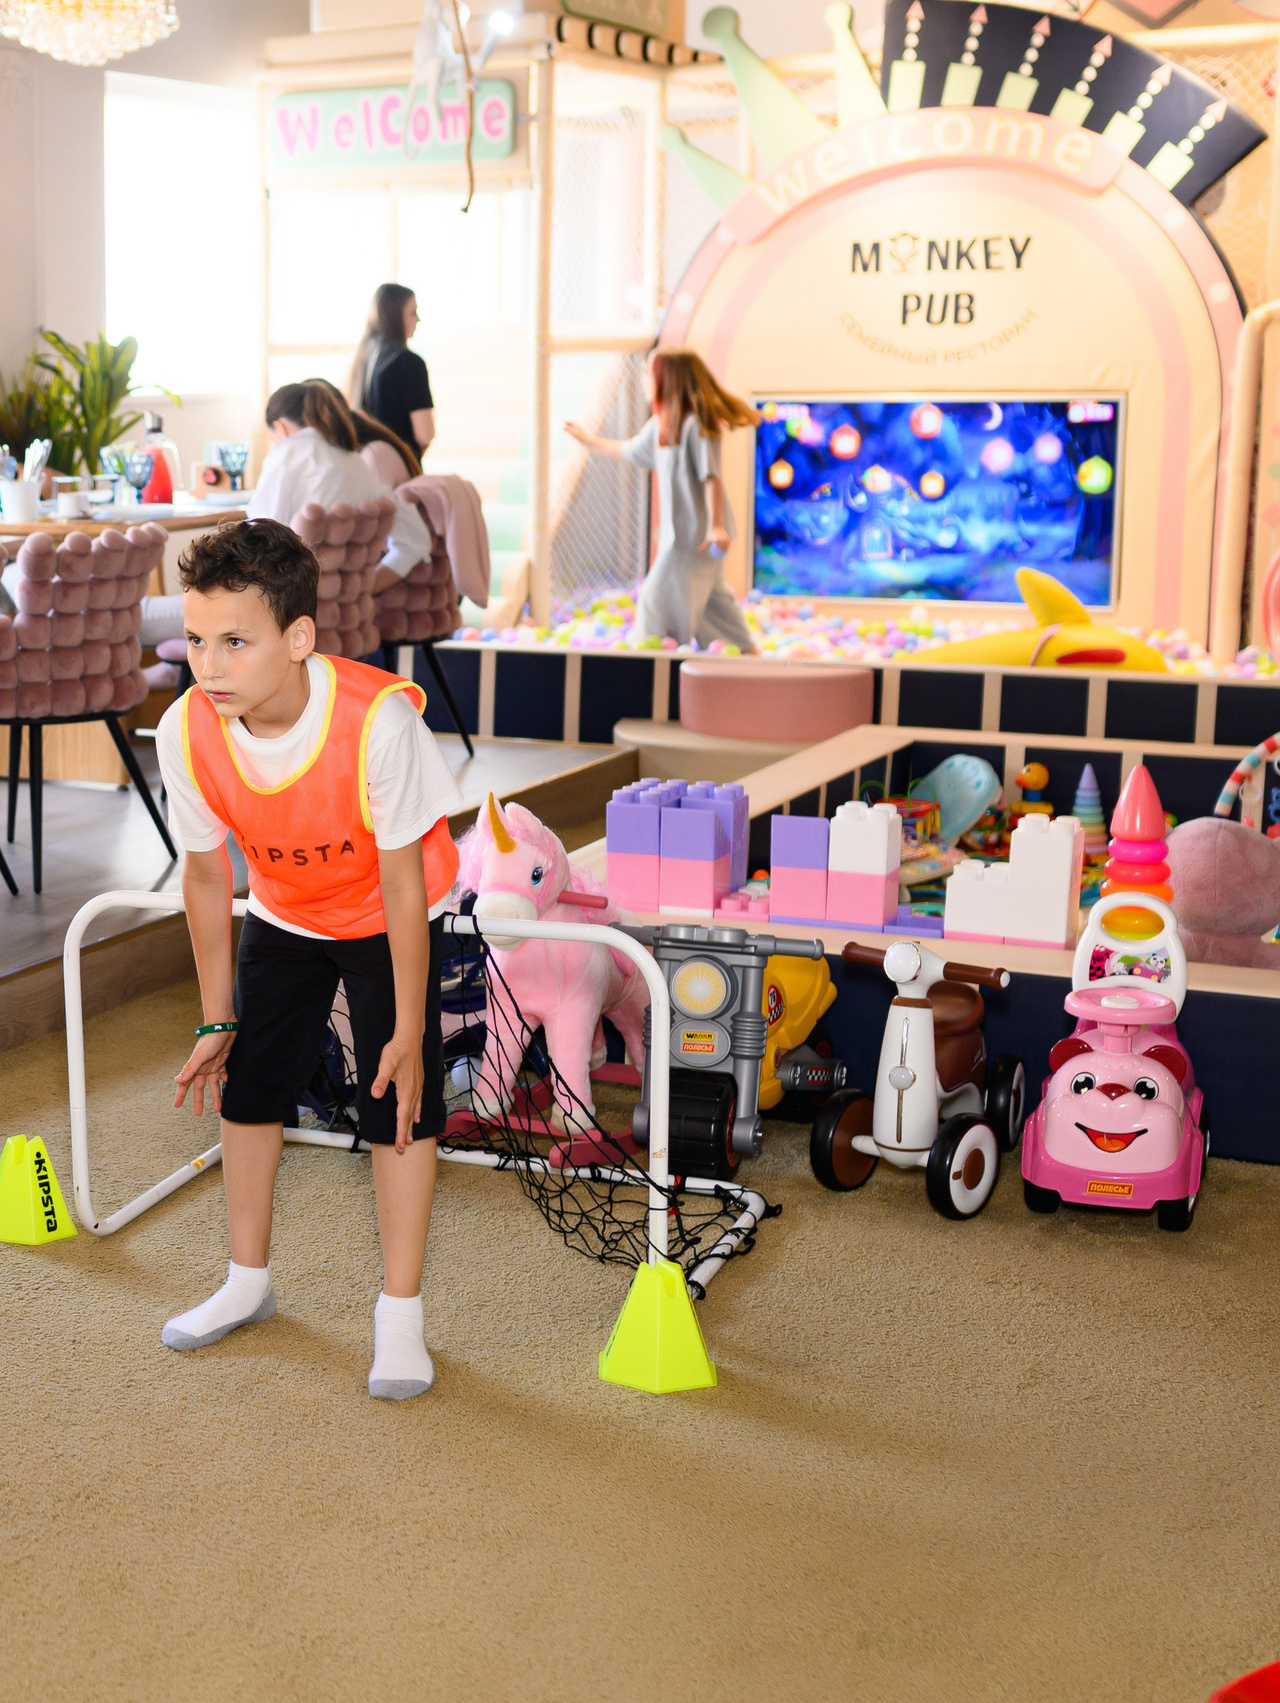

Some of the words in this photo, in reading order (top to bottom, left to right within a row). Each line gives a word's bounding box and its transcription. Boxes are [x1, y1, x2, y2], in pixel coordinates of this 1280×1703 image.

[756, 109, 1094, 214] welcome
[900, 292, 975, 326] PUB
[943, 307, 1038, 364] РЕСТОРАН
[241, 836, 355, 866] IPSTA
[1089, 1183, 1130, 1194] ПОЛЕСЬЕ
